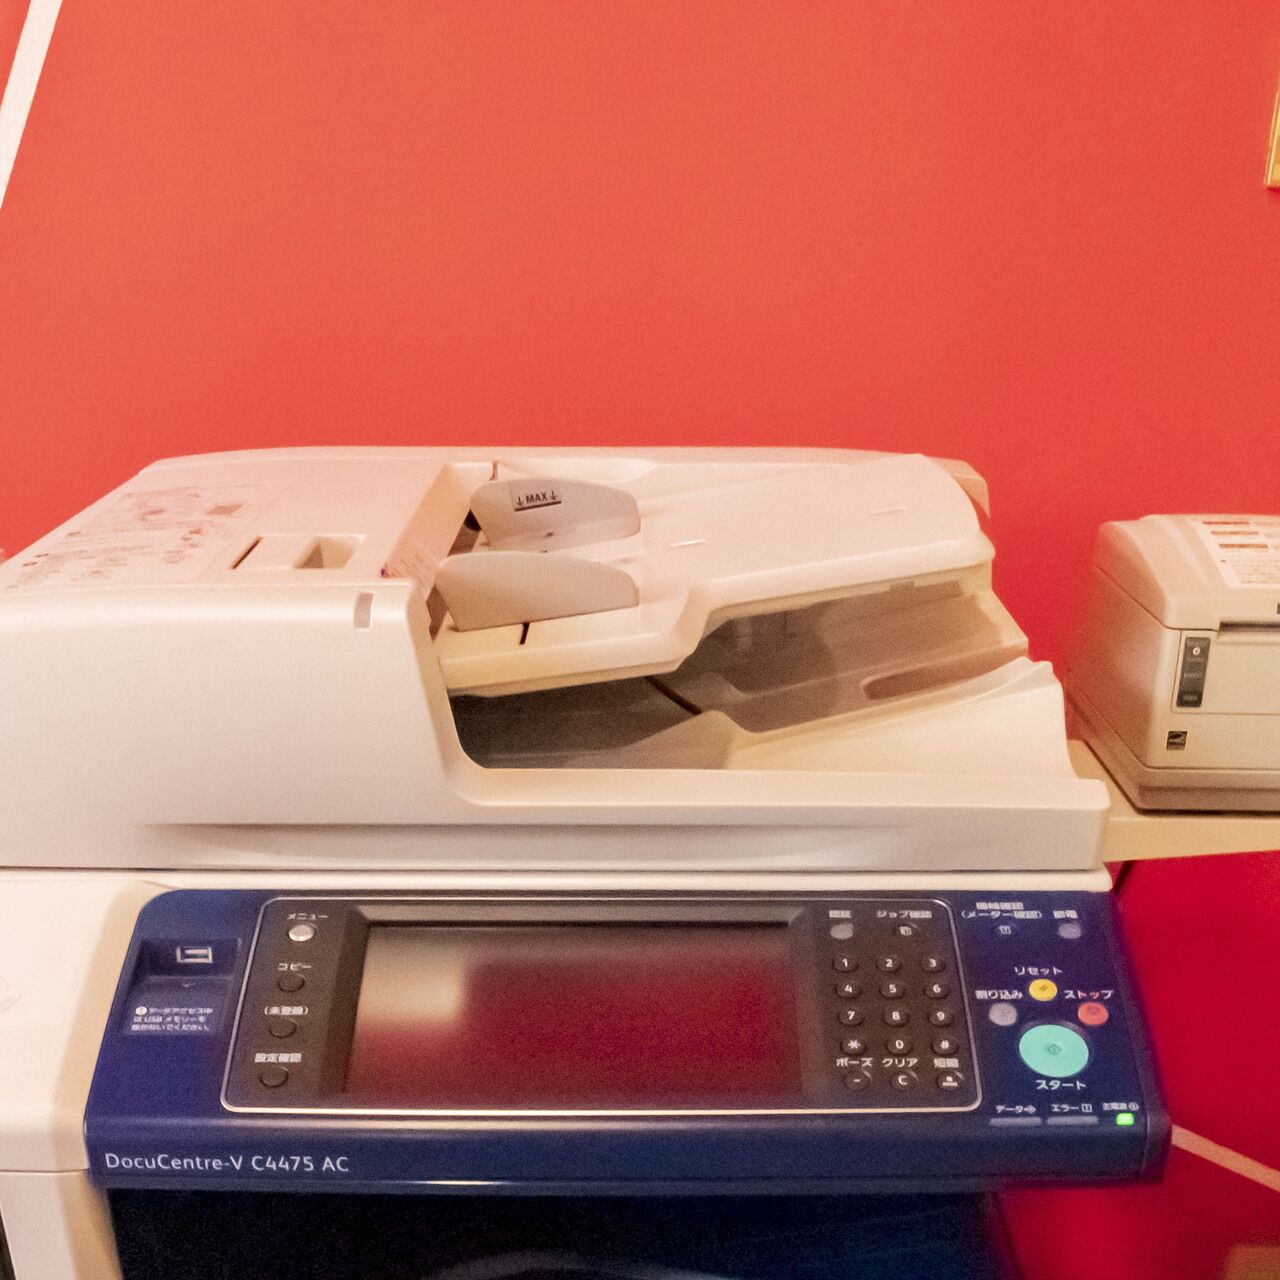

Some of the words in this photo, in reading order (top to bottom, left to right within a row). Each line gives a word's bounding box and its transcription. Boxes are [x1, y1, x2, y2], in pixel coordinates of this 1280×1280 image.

[525, 492, 548, 504] MAX
[277, 963, 312, 971] コピー
[842, 958, 848, 968] 1
[885, 958, 893, 968] 2
[929, 958, 937, 968] 3
[1014, 966, 1063, 976] リセット
[844, 984, 853, 993] 4
[889, 984, 897, 993] 5
[933, 984, 941, 993] 6
[1064, 989, 1115, 999] ストップ
[847, 1011, 855, 1020] 7
[891, 1011, 900, 1020] 8
[936, 1011, 945, 1020] 9
[895, 1040, 904, 1049] 0
[881, 1057, 918, 1067] クリア
[898, 1075, 907, 1085] C
[1035, 1079, 1086, 1090] スタート
[105, 1153, 243, 1171] DocuCentre-V
[251, 1155, 314, 1171] C4475
[322, 1156, 349, 1172] AC
